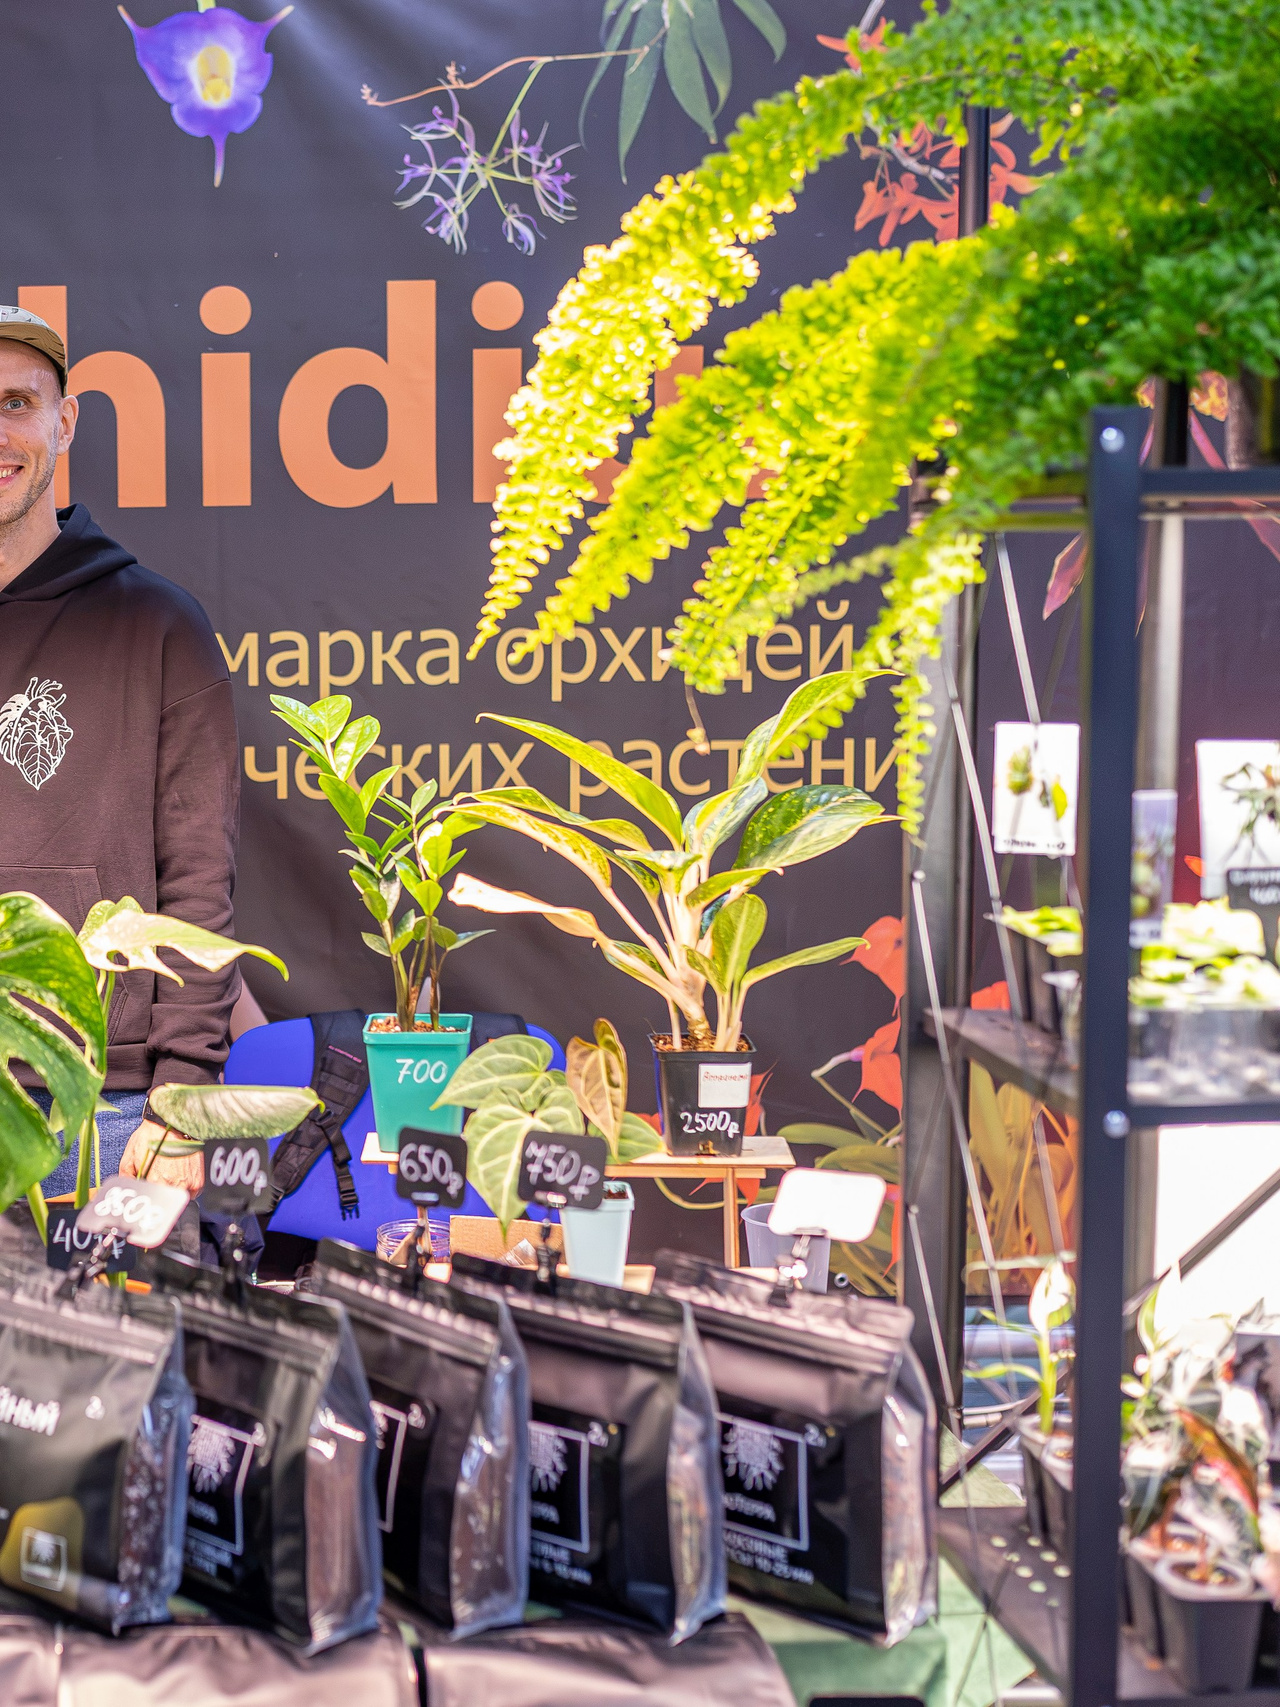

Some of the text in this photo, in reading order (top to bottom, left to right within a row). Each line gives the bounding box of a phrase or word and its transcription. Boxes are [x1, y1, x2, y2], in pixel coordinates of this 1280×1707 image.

[215, 627, 461, 700] марка
[496, 599, 854, 702] орхей
[244, 740, 535, 801] ческих
[570, 736, 908, 814] растени
[395, 1058, 448, 1085] 700
